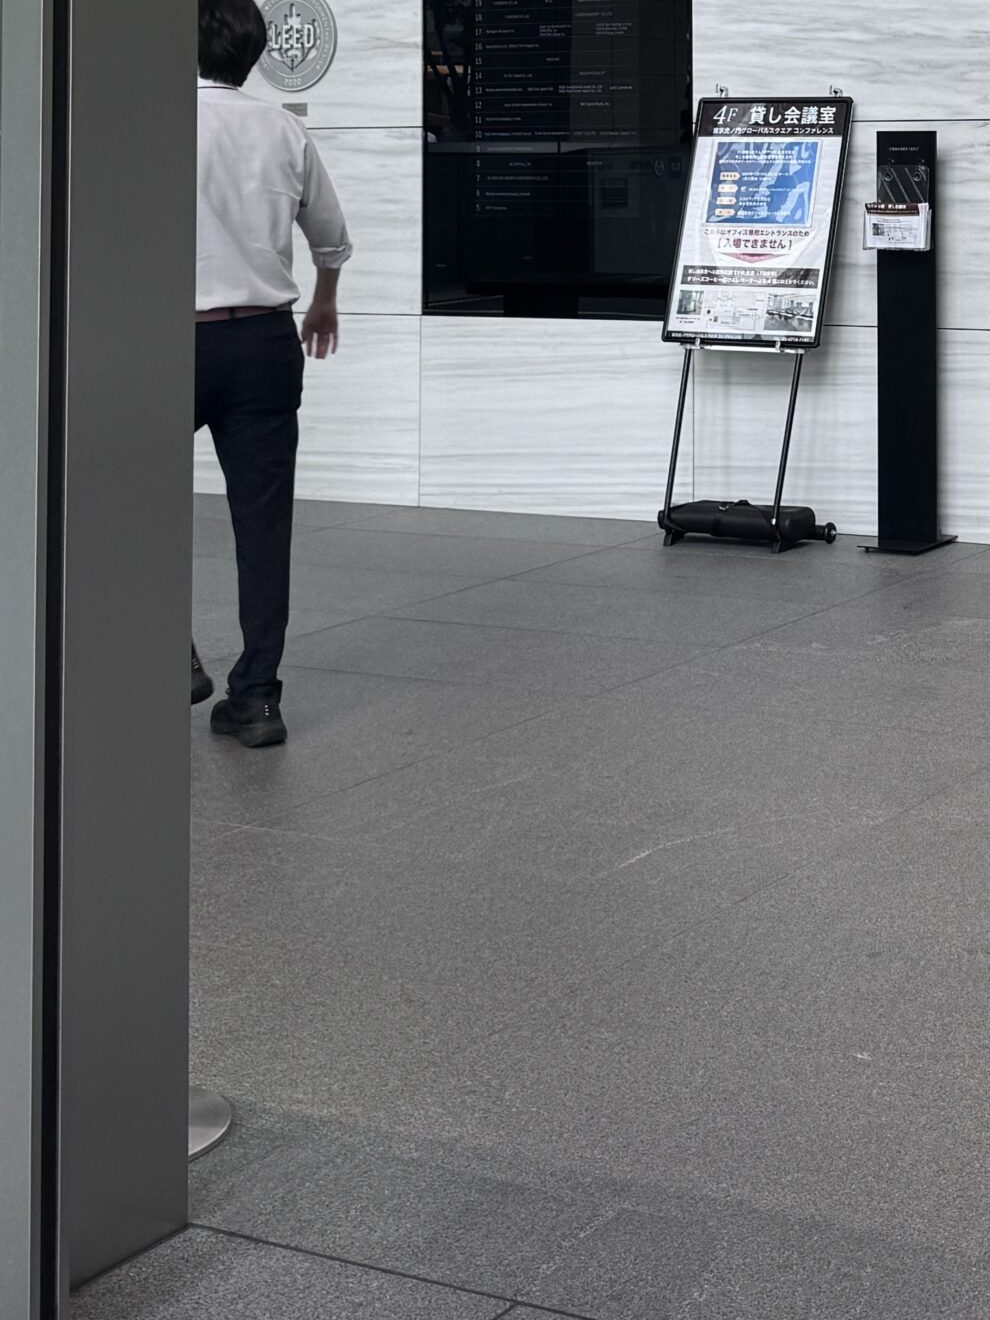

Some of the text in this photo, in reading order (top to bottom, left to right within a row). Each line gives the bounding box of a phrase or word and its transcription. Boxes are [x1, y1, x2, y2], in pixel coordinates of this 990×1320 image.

[271, 24, 314, 49] LEED
[713, 105, 836, 125] 4F 貸し会議室
